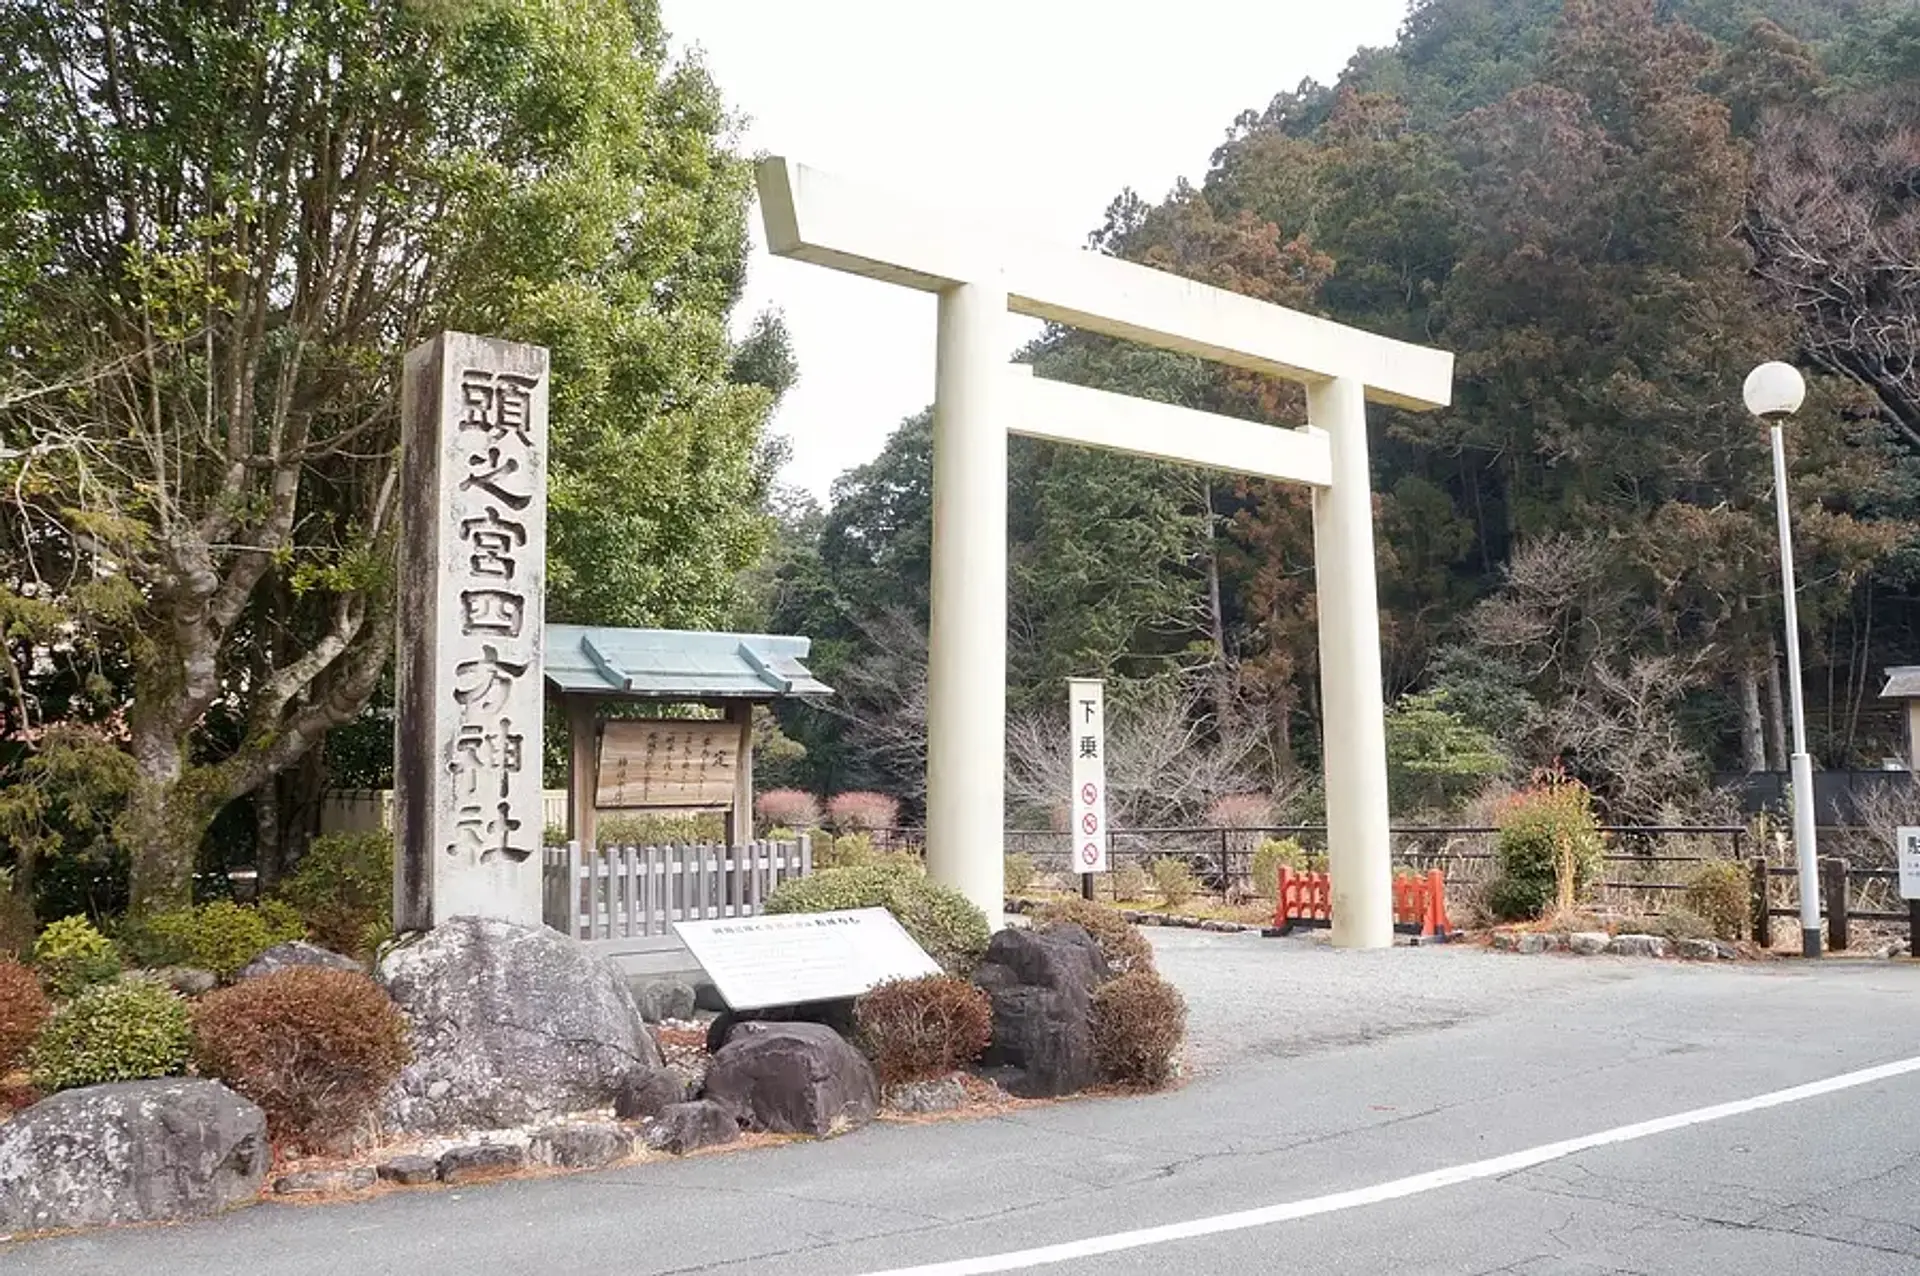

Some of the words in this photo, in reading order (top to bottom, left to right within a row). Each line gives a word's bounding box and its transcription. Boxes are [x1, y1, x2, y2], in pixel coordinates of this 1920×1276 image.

[446, 368, 540, 866] 頭之宮四方神社
[1079, 700, 1098, 759] 下乗
